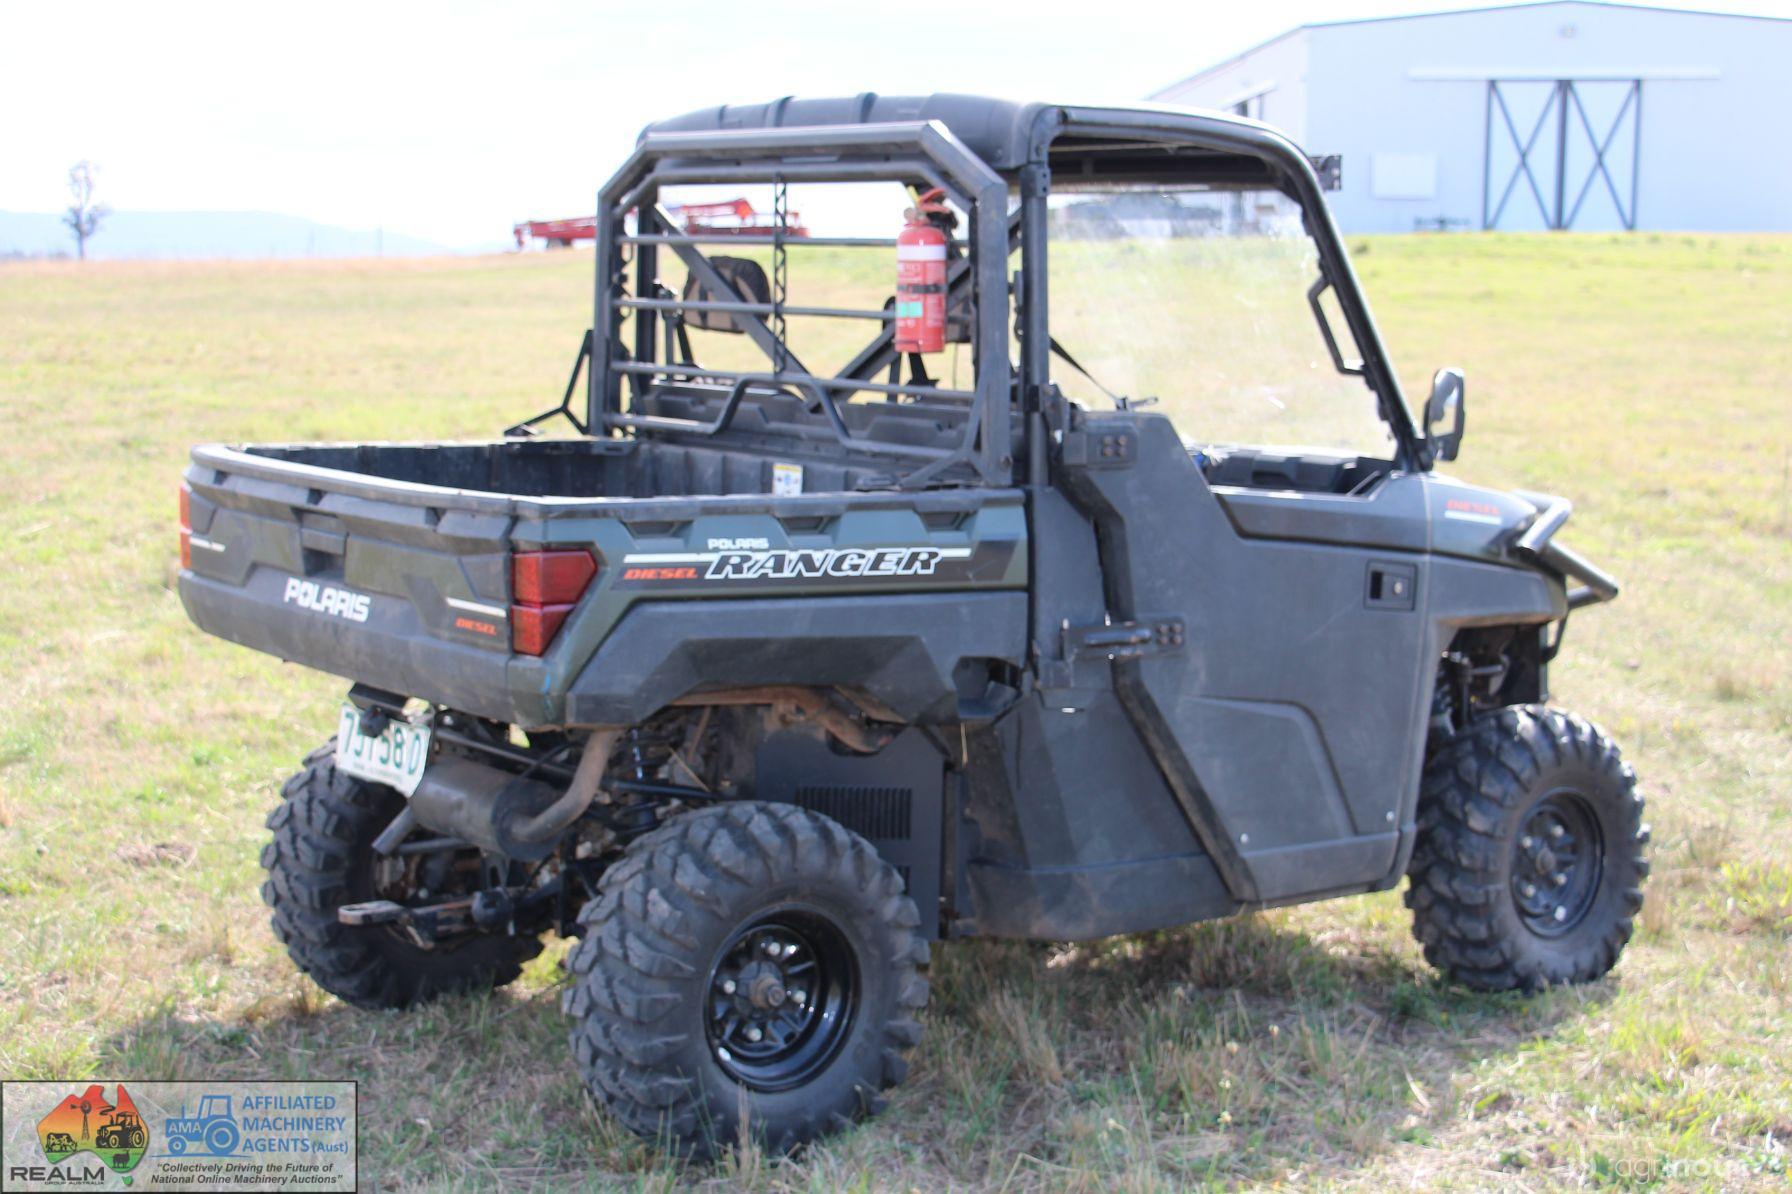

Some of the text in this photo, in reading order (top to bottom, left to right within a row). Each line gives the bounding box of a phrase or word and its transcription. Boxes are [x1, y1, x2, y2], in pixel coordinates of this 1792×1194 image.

[708, 538, 769, 550] POLARIS
[623, 567, 698, 580] DIESEL
[704, 547, 943, 580] RANGER
[284, 577, 371, 623] POLARIS
[455, 616, 497, 636] DIESEL
